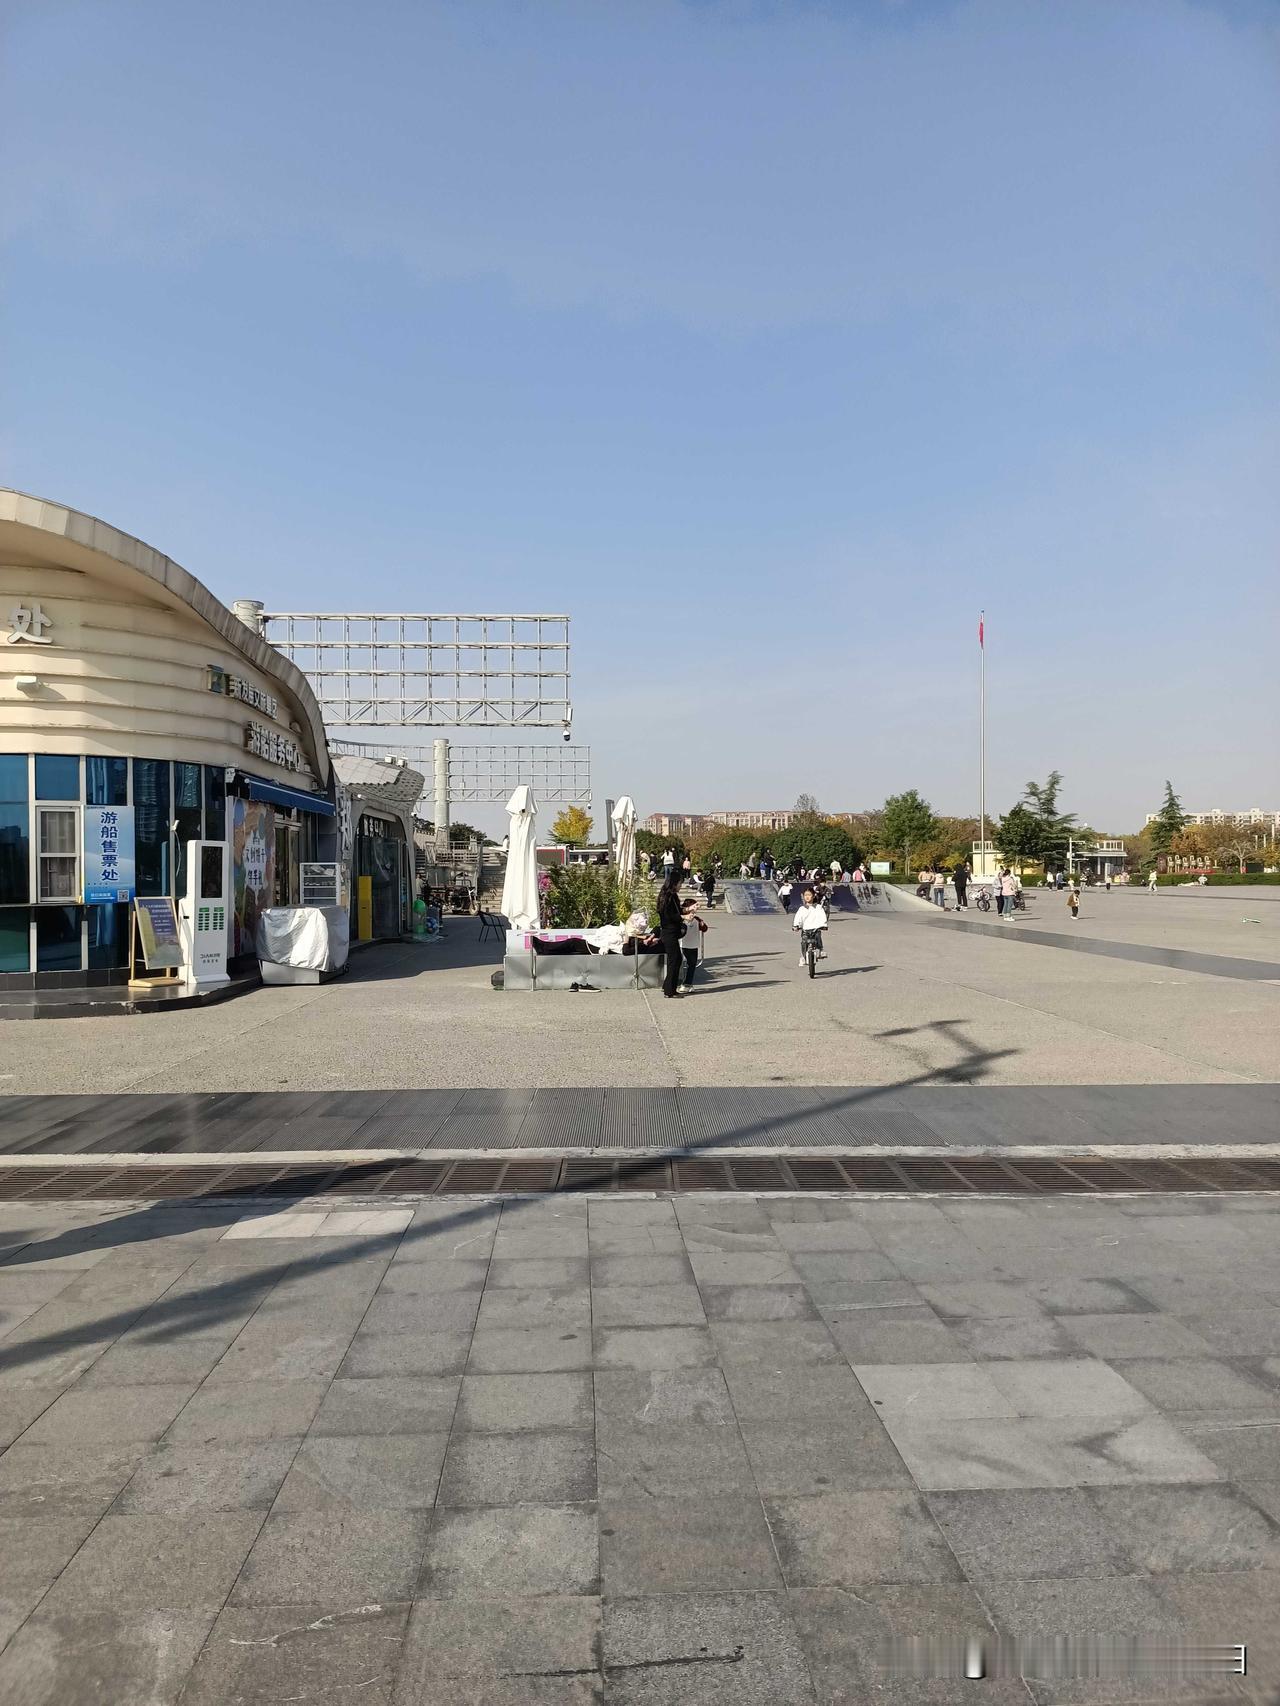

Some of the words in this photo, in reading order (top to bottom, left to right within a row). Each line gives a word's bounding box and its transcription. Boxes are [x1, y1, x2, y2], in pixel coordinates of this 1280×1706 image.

[7, 600, 54, 645] 处
[247, 720, 301, 773] 游船服务中心
[101, 811, 119, 881] 游船售票处
